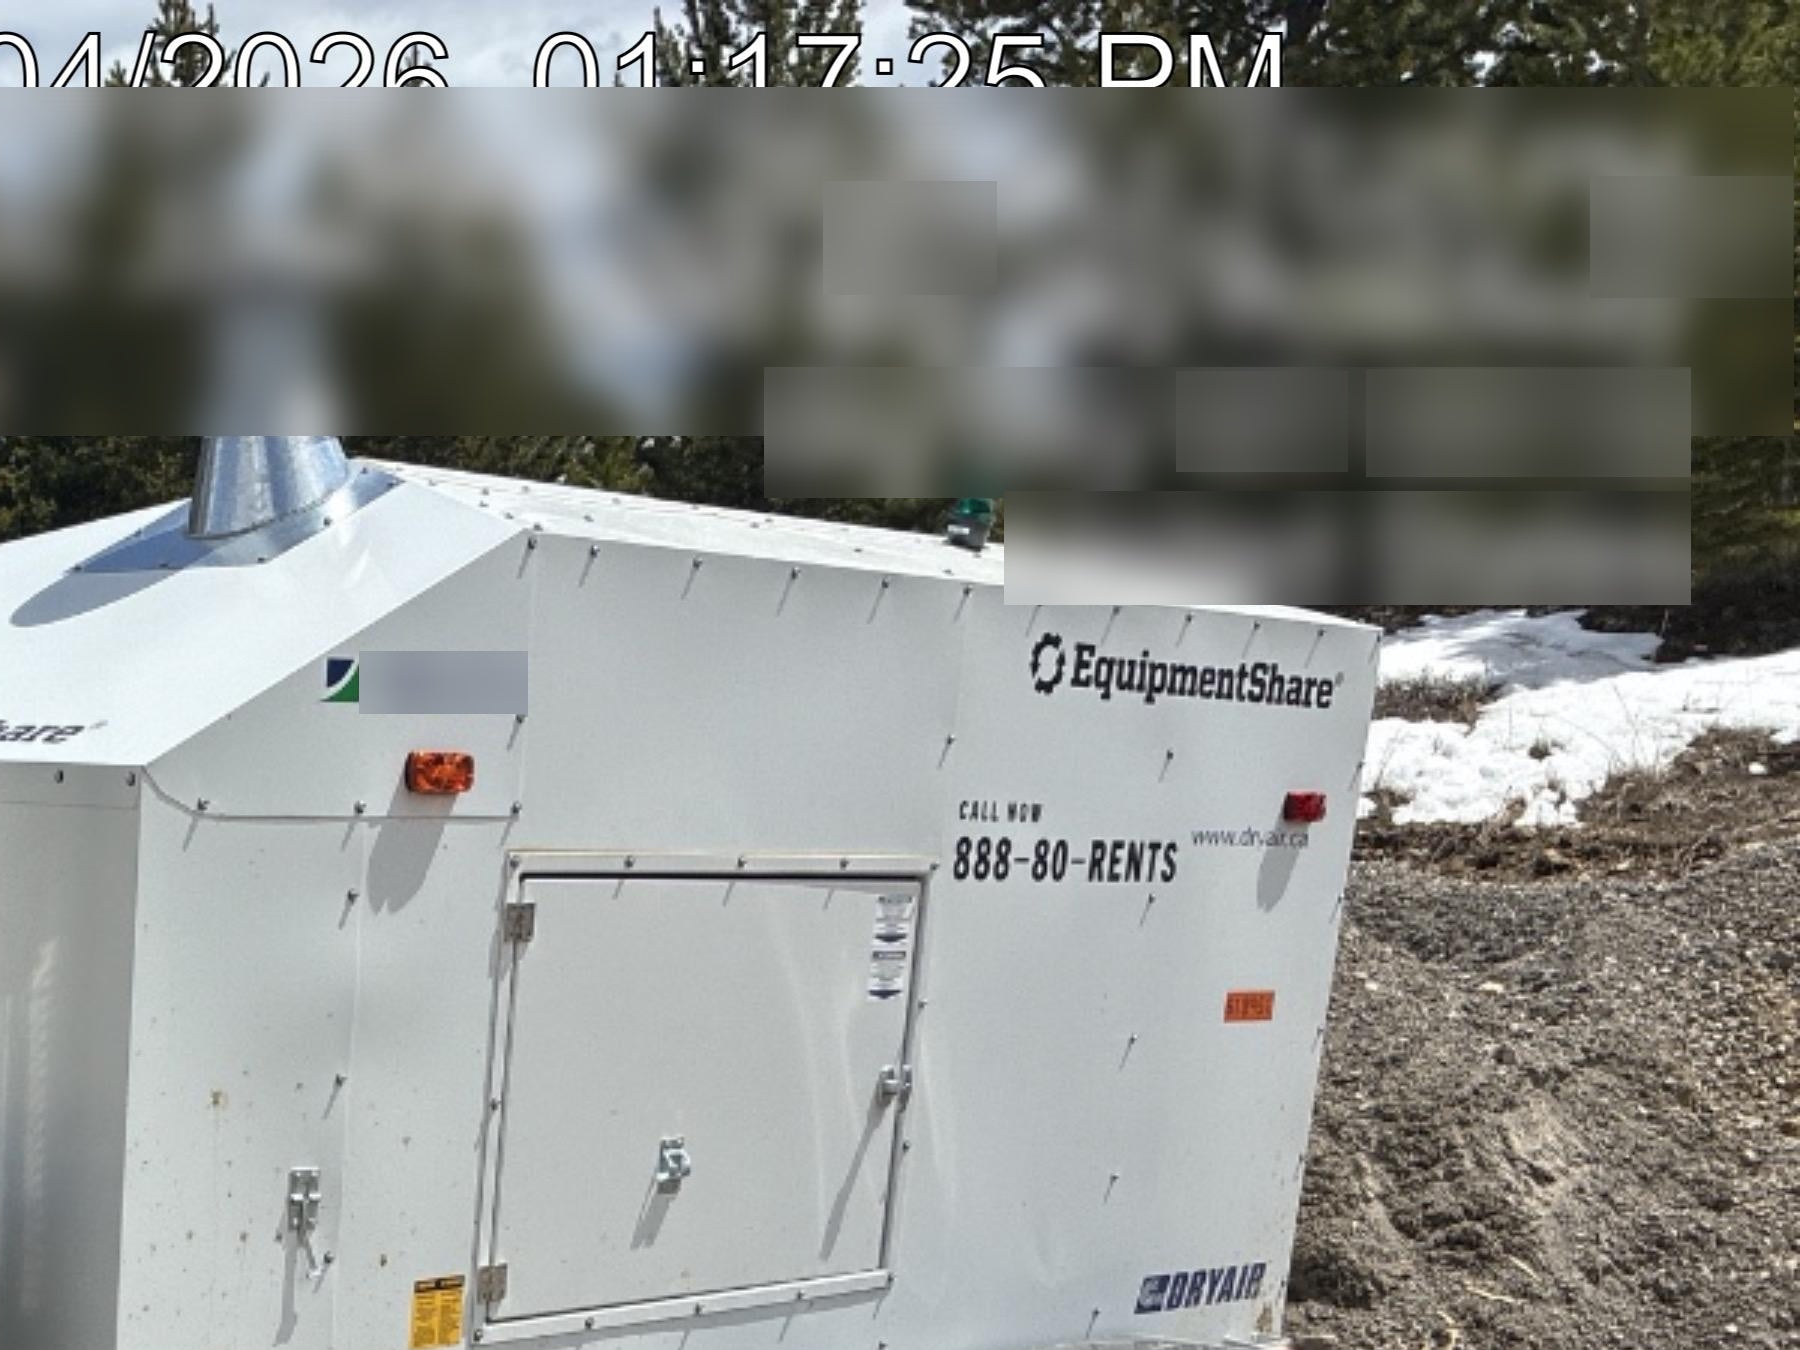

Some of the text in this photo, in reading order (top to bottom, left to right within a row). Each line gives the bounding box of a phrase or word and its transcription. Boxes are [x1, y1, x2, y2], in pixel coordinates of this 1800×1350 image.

[1070, 641, 1333, 709] EquipmentShare
[958, 800, 1043, 823] CALL NOW
[952, 836, 1179, 883] 888-80-RENTS
[1164, 1261, 1268, 1311] DRYAIR
